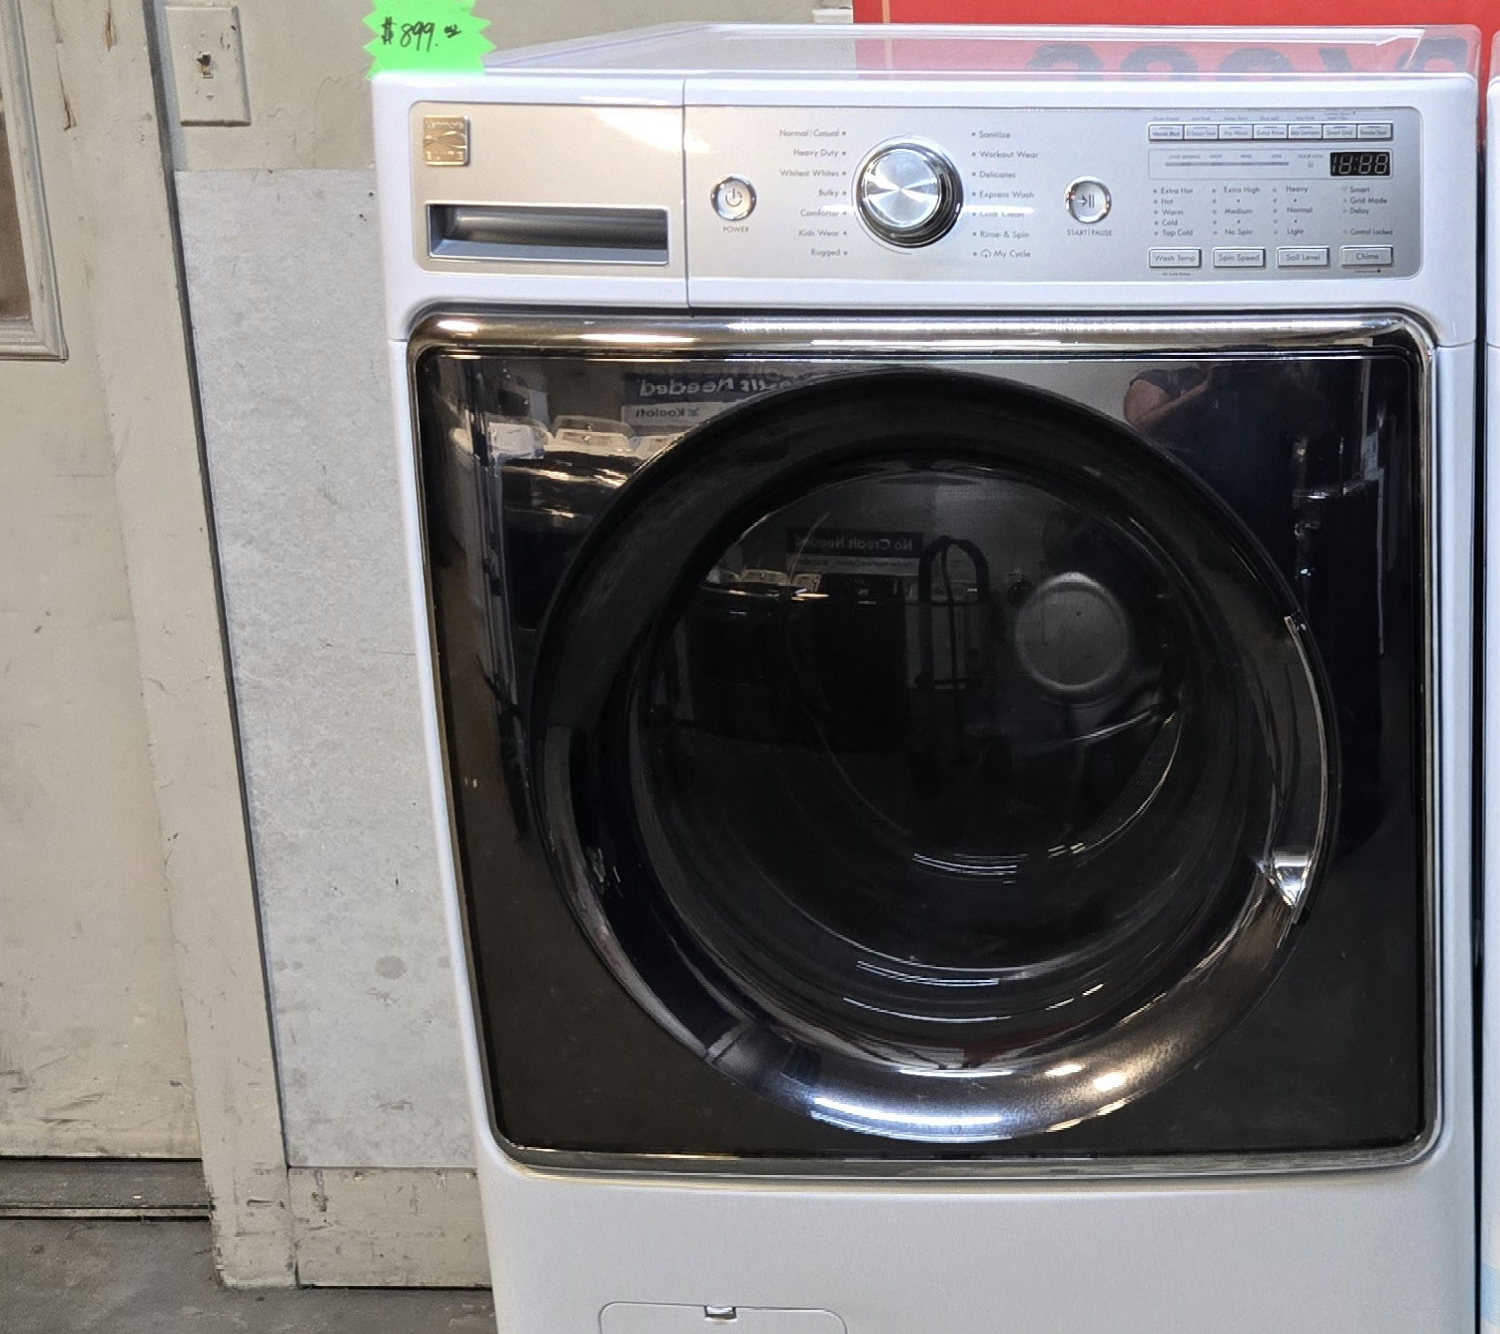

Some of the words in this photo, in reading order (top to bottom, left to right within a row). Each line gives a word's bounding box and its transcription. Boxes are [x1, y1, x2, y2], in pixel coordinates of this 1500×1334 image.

[979, 131, 1010, 139] Sanitize
[794, 149, 817, 157] Heavy
[821, 149, 838, 157] Duty
[1013, 231, 1029, 239] Spin
[811, 249, 840, 257] Rugged
[1010, 250, 1031, 258] Cycle
[1219, 254, 1234, 262] Spin
[1237, 254, 1259, 262] Speed
